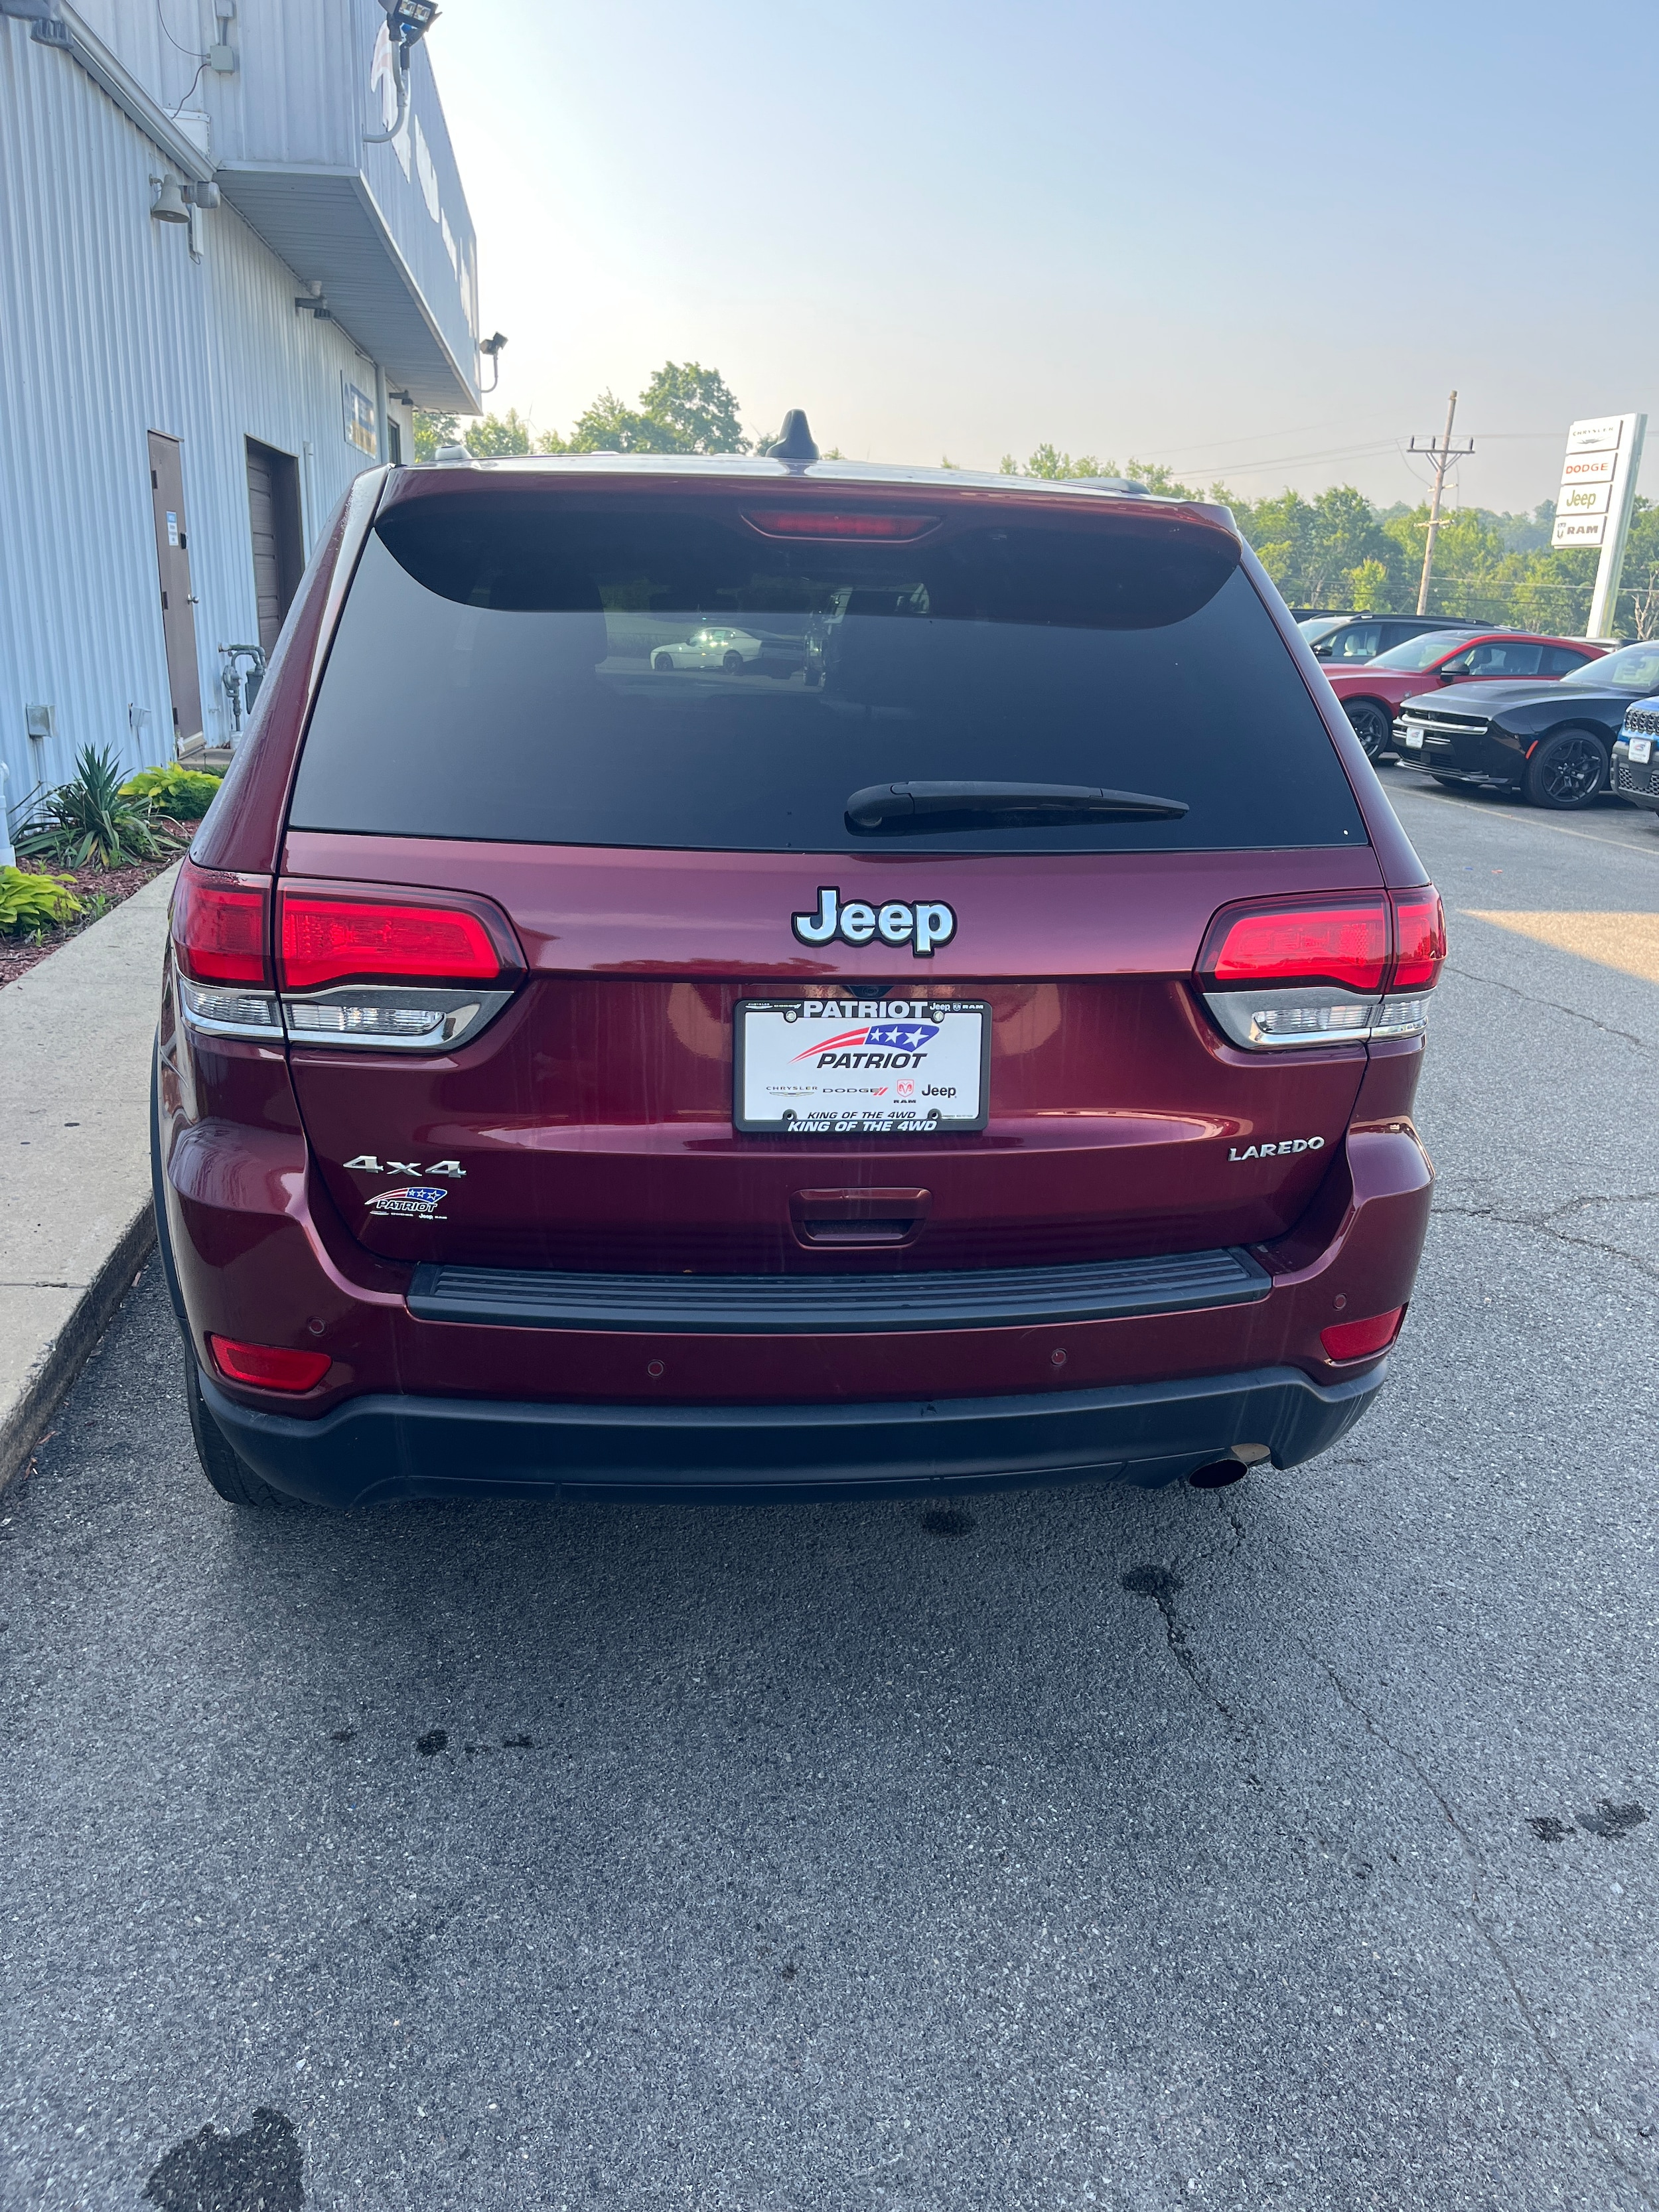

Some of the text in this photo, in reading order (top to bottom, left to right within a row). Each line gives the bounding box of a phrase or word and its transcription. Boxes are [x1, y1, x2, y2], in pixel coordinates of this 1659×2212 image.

[1565, 463, 1609, 475] DODGE
[1566, 489, 1596, 509] Jeep
[1567, 526, 1599, 534] RAM
[795, 888, 954, 954] Jeep
[804, 1001, 928, 1018] PATRIOT
[929, 1002, 950, 1011] Jeep
[817, 1053, 928, 1069] PATRIOT
[922, 1084, 956, 1098] Jeep
[788, 1121, 937, 1132] KING OF THE 4WD
[1228, 1136, 1325, 1161] LAREDO
[376, 1200, 438, 1213] PATRIOT
